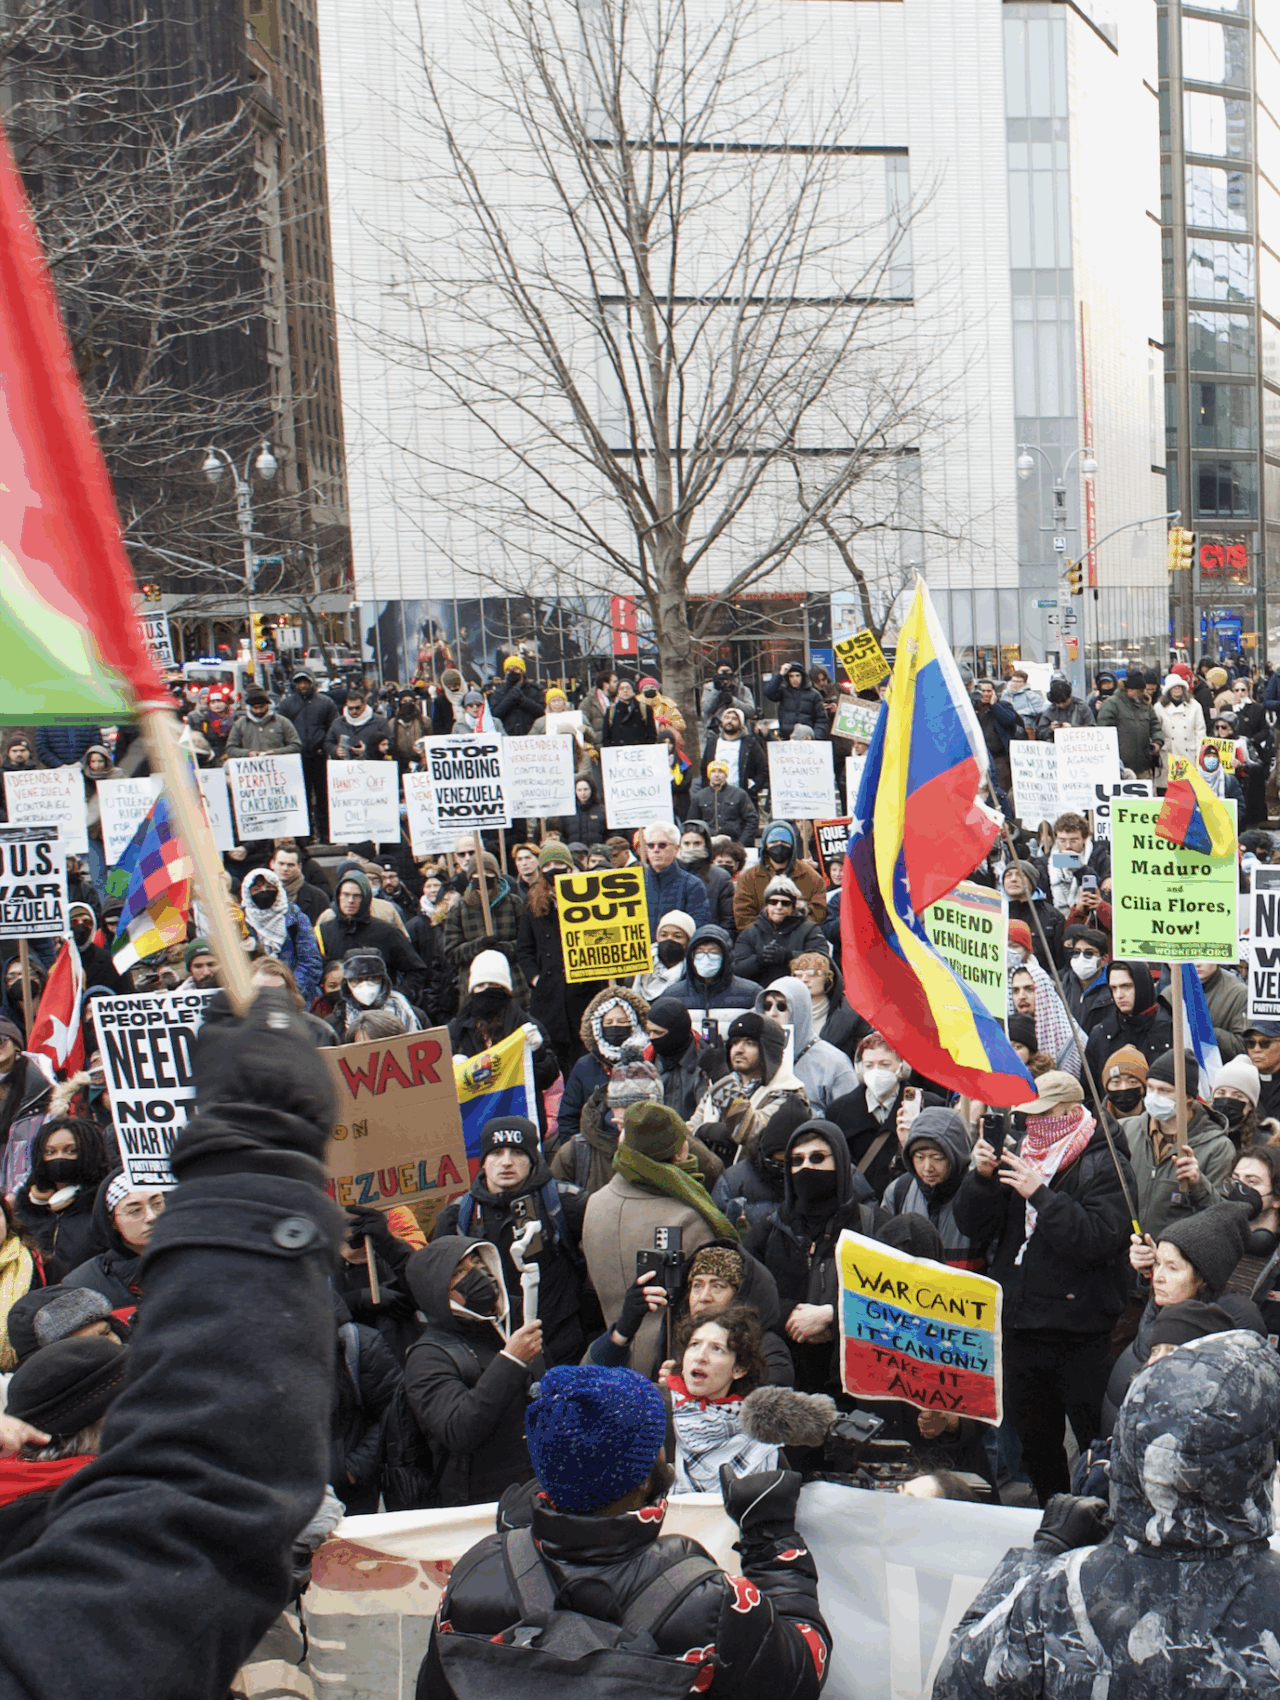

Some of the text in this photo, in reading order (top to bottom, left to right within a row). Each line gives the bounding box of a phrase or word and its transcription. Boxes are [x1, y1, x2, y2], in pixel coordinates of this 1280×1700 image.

[1200, 544, 1247, 568] CVS
[145, 622, 167, 639] U.S.
[837, 633, 872, 655] US
[844, 645, 875, 664] OUT
[430, 745, 498, 759] STOP
[509, 754, 560, 763] VENEZUELA
[616, 749, 646, 762] FREE
[235, 759, 277, 774] YANKEE
[432, 758, 500, 780] BOMBING
[609, 766, 654, 779] NICOLAS
[782, 767, 820, 775] AGAINST
[239, 772, 287, 788] PIRATES
[333, 776, 386, 789] HANDS OFF
[14, 786, 71, 799] VENEZUELA
[240, 786, 286, 798] OUT OF THE
[436, 785, 504, 804] VENEZUELA
[611, 785, 661, 799] MADURO!
[1095, 783, 1149, 802] US
[240, 795, 298, 813] CARIBBEAN
[331, 797, 388, 808] VENEZUELAN
[438, 803, 504, 817] NOW!
[344, 810, 368, 822] OIL!
[1118, 809, 1159, 824] Free
[10, 843, 60, 877] U.S.
[1132, 860, 1211, 876] Maduro
[560, 873, 640, 903] US
[1166, 885, 1184, 893] and
[564, 900, 642, 923] OUT
[1121, 896, 1231, 917] Cilia Flores,
[566, 924, 645, 948] OF THE
[1152, 920, 1200, 935] Now!
[568, 942, 648, 967] CARIBBEAN
[933, 929, 999, 962] VENEUELA'S
[1155, 948, 1229, 957] WORKERS.ORG
[97, 999, 166, 1013] MONEY
[100, 1009, 203, 1027] PEOPLE'
[103, 1027, 198, 1089] NEED
[338, 1040, 442, 1100] WAR
[332, 1119, 368, 1141] ON
[492, 1130, 523, 1144] NYC
[121, 1128, 161, 1155] WAR
[130, 1160, 148, 1171] PARTY
[852, 1263, 988, 1320] WAR CAN'T
[866, 1300, 915, 1330] GIVE
[857, 1323, 988, 1372] IT CAN ONLY
[871, 1348, 964, 1387] TAKE IT
[888, 1374, 967, 1410] AWAY.
